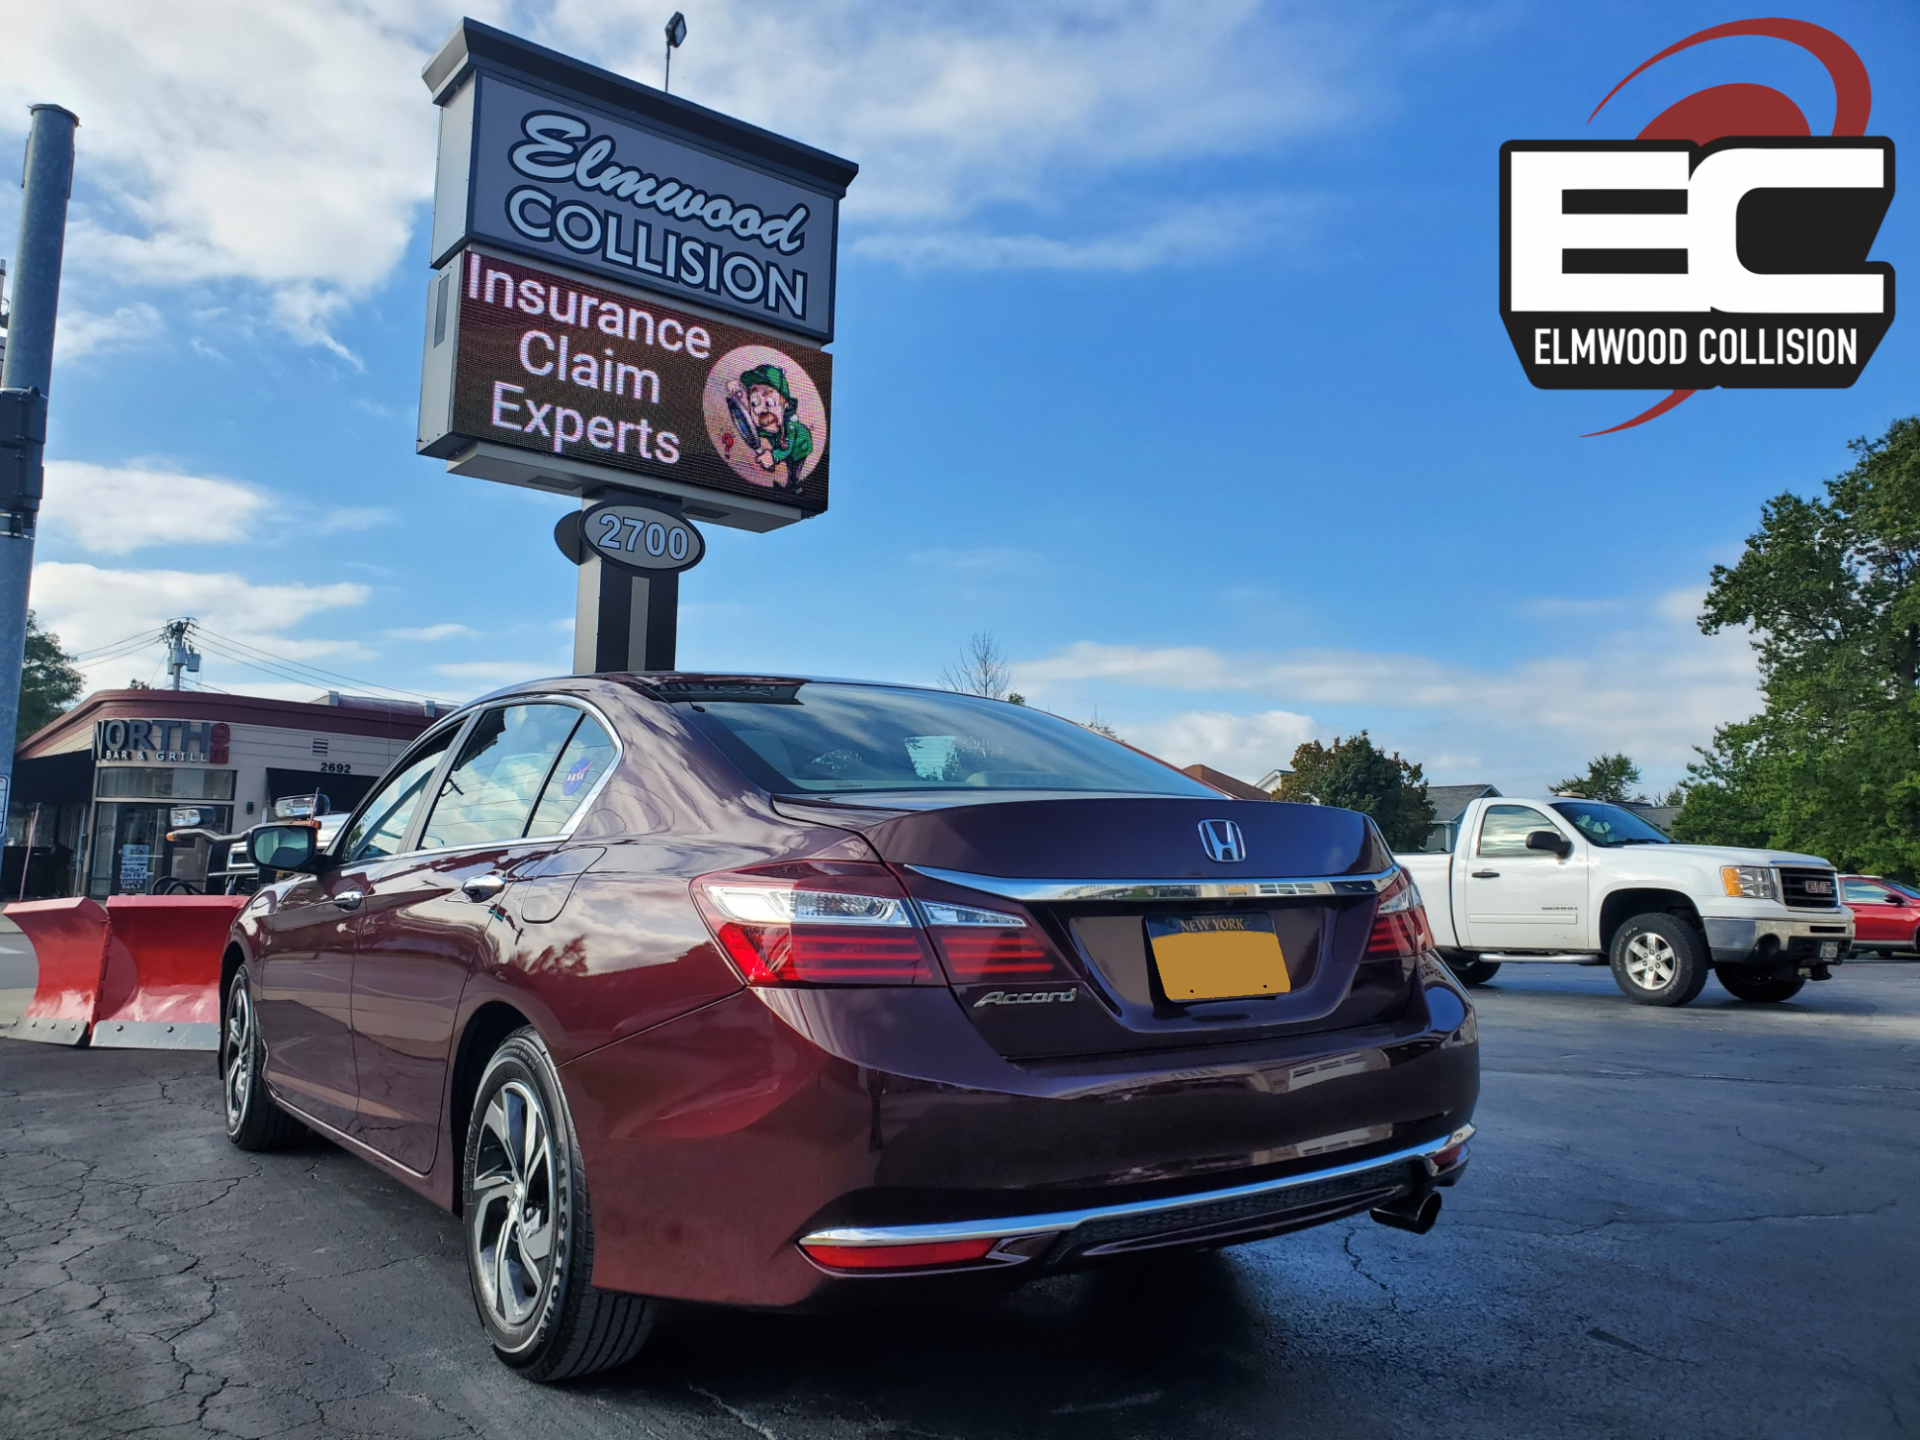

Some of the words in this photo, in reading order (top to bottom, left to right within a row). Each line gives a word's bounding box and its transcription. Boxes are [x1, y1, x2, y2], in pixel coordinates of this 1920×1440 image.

[510, 112, 808, 253] Elmwood
[507, 187, 806, 318] COLLISION
[469, 253, 711, 359] Insurance
[520, 329, 660, 404] Claim
[492, 381, 680, 464] Experts
[598, 513, 689, 561] 2700
[106, 749, 130, 760] BAR
[137, 750, 146, 760] &
[155, 751, 208, 763] GRILL
[320, 761, 352, 774] 2692
[1179, 918, 1209, 932] NEW
[1212, 917, 1245, 931] YORK
[973, 987, 1077, 1007] Accord
